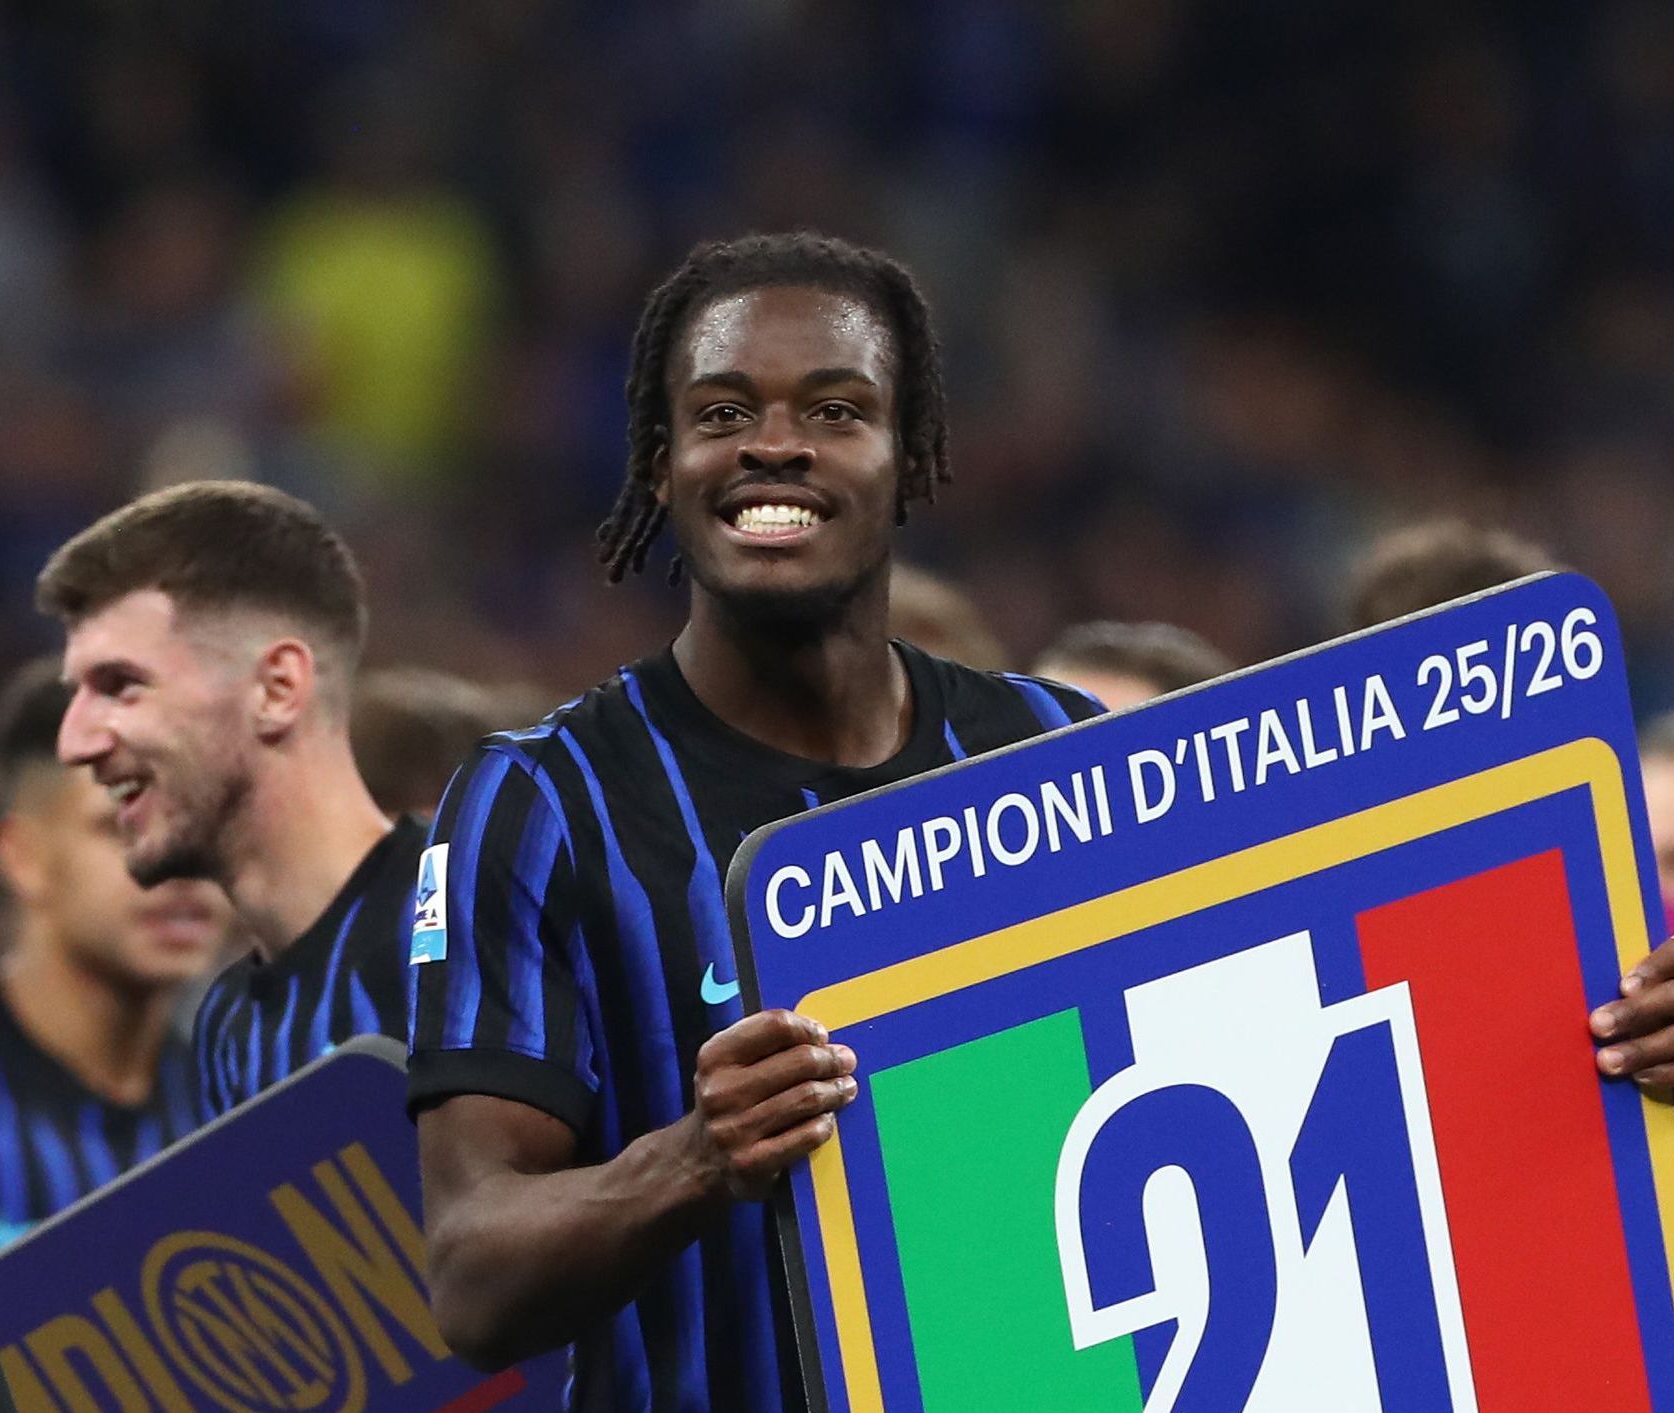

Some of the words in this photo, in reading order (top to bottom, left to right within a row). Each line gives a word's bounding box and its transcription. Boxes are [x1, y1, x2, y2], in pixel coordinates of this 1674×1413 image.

[765, 765, 1113, 939] CAMPIONI
[1128, 674, 1407, 824] D’ITALIA
[1417, 607, 1604, 731] 25/26
